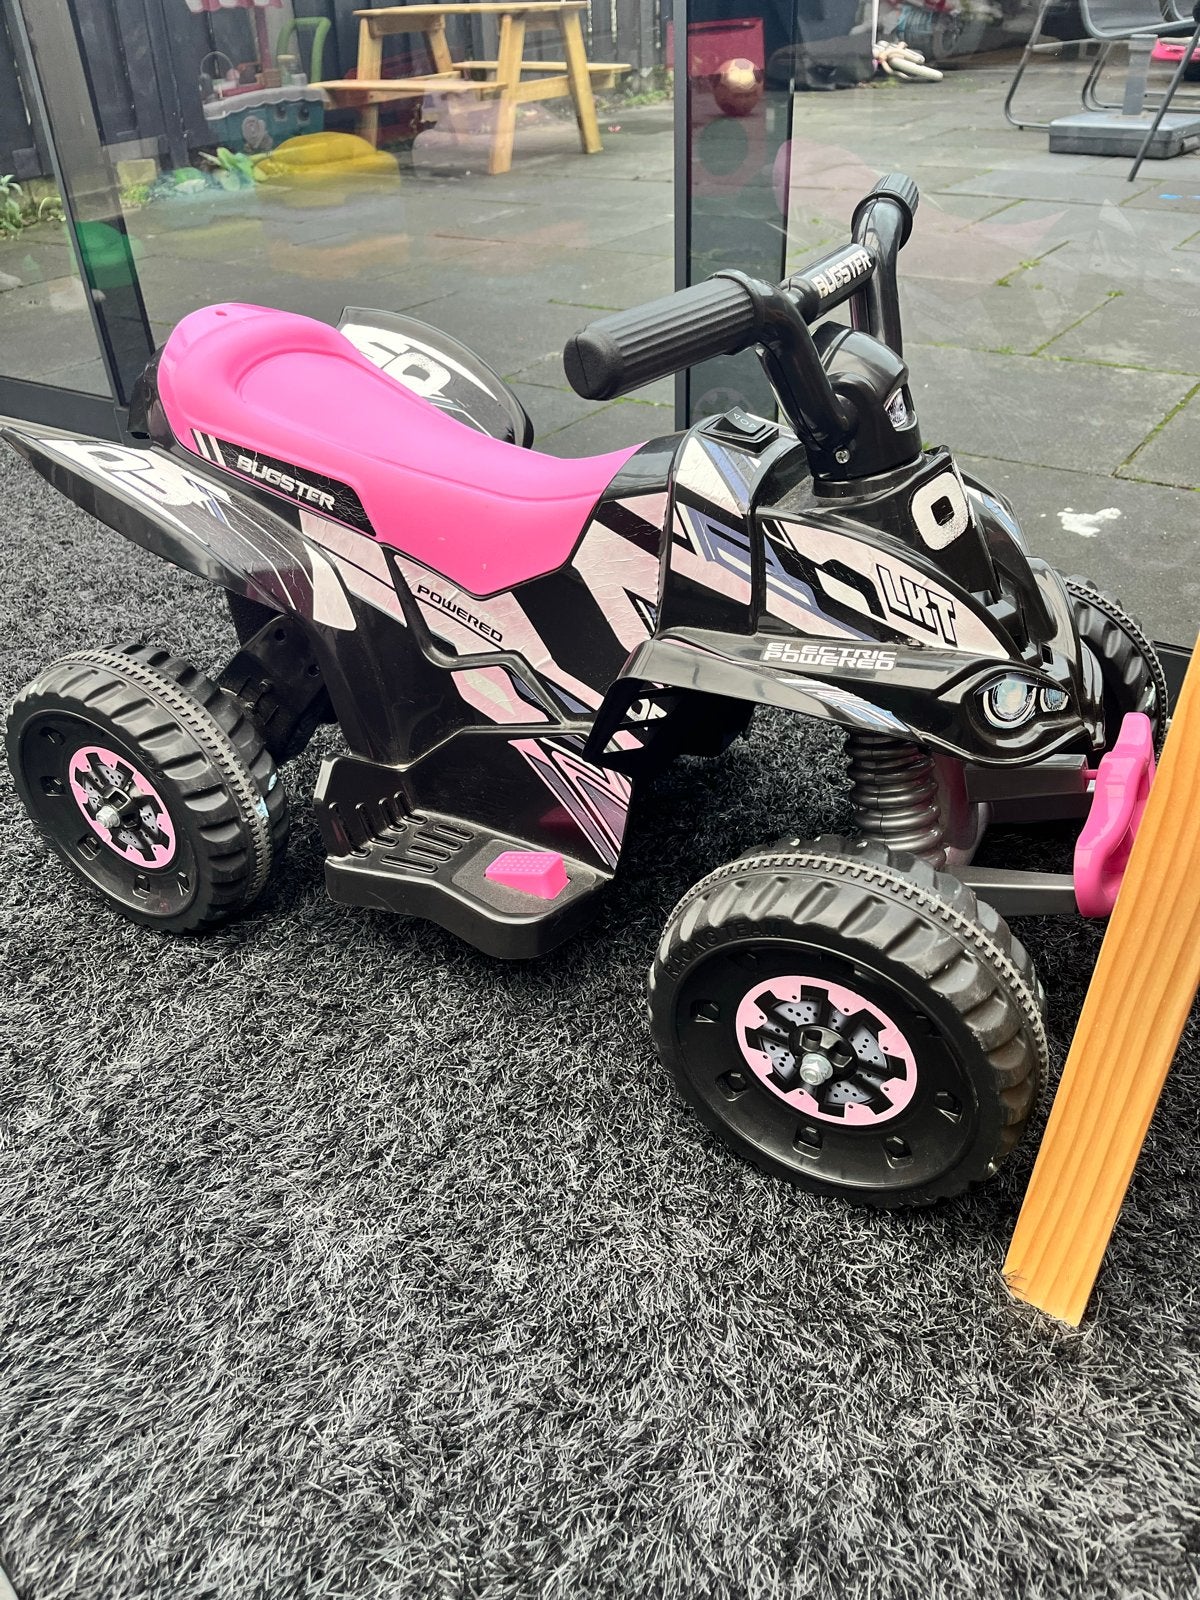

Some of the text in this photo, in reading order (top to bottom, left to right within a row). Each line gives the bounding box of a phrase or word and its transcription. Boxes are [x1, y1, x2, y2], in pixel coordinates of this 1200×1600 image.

[811, 249, 872, 299] BUGSTER
[236, 453, 336, 512] BUGSTER
[416, 583, 504, 643] POWERED
[876, 563, 958, 649] LKT
[763, 651, 896, 671] POWERED
[766, 642, 898, 662] ELECTRIC
